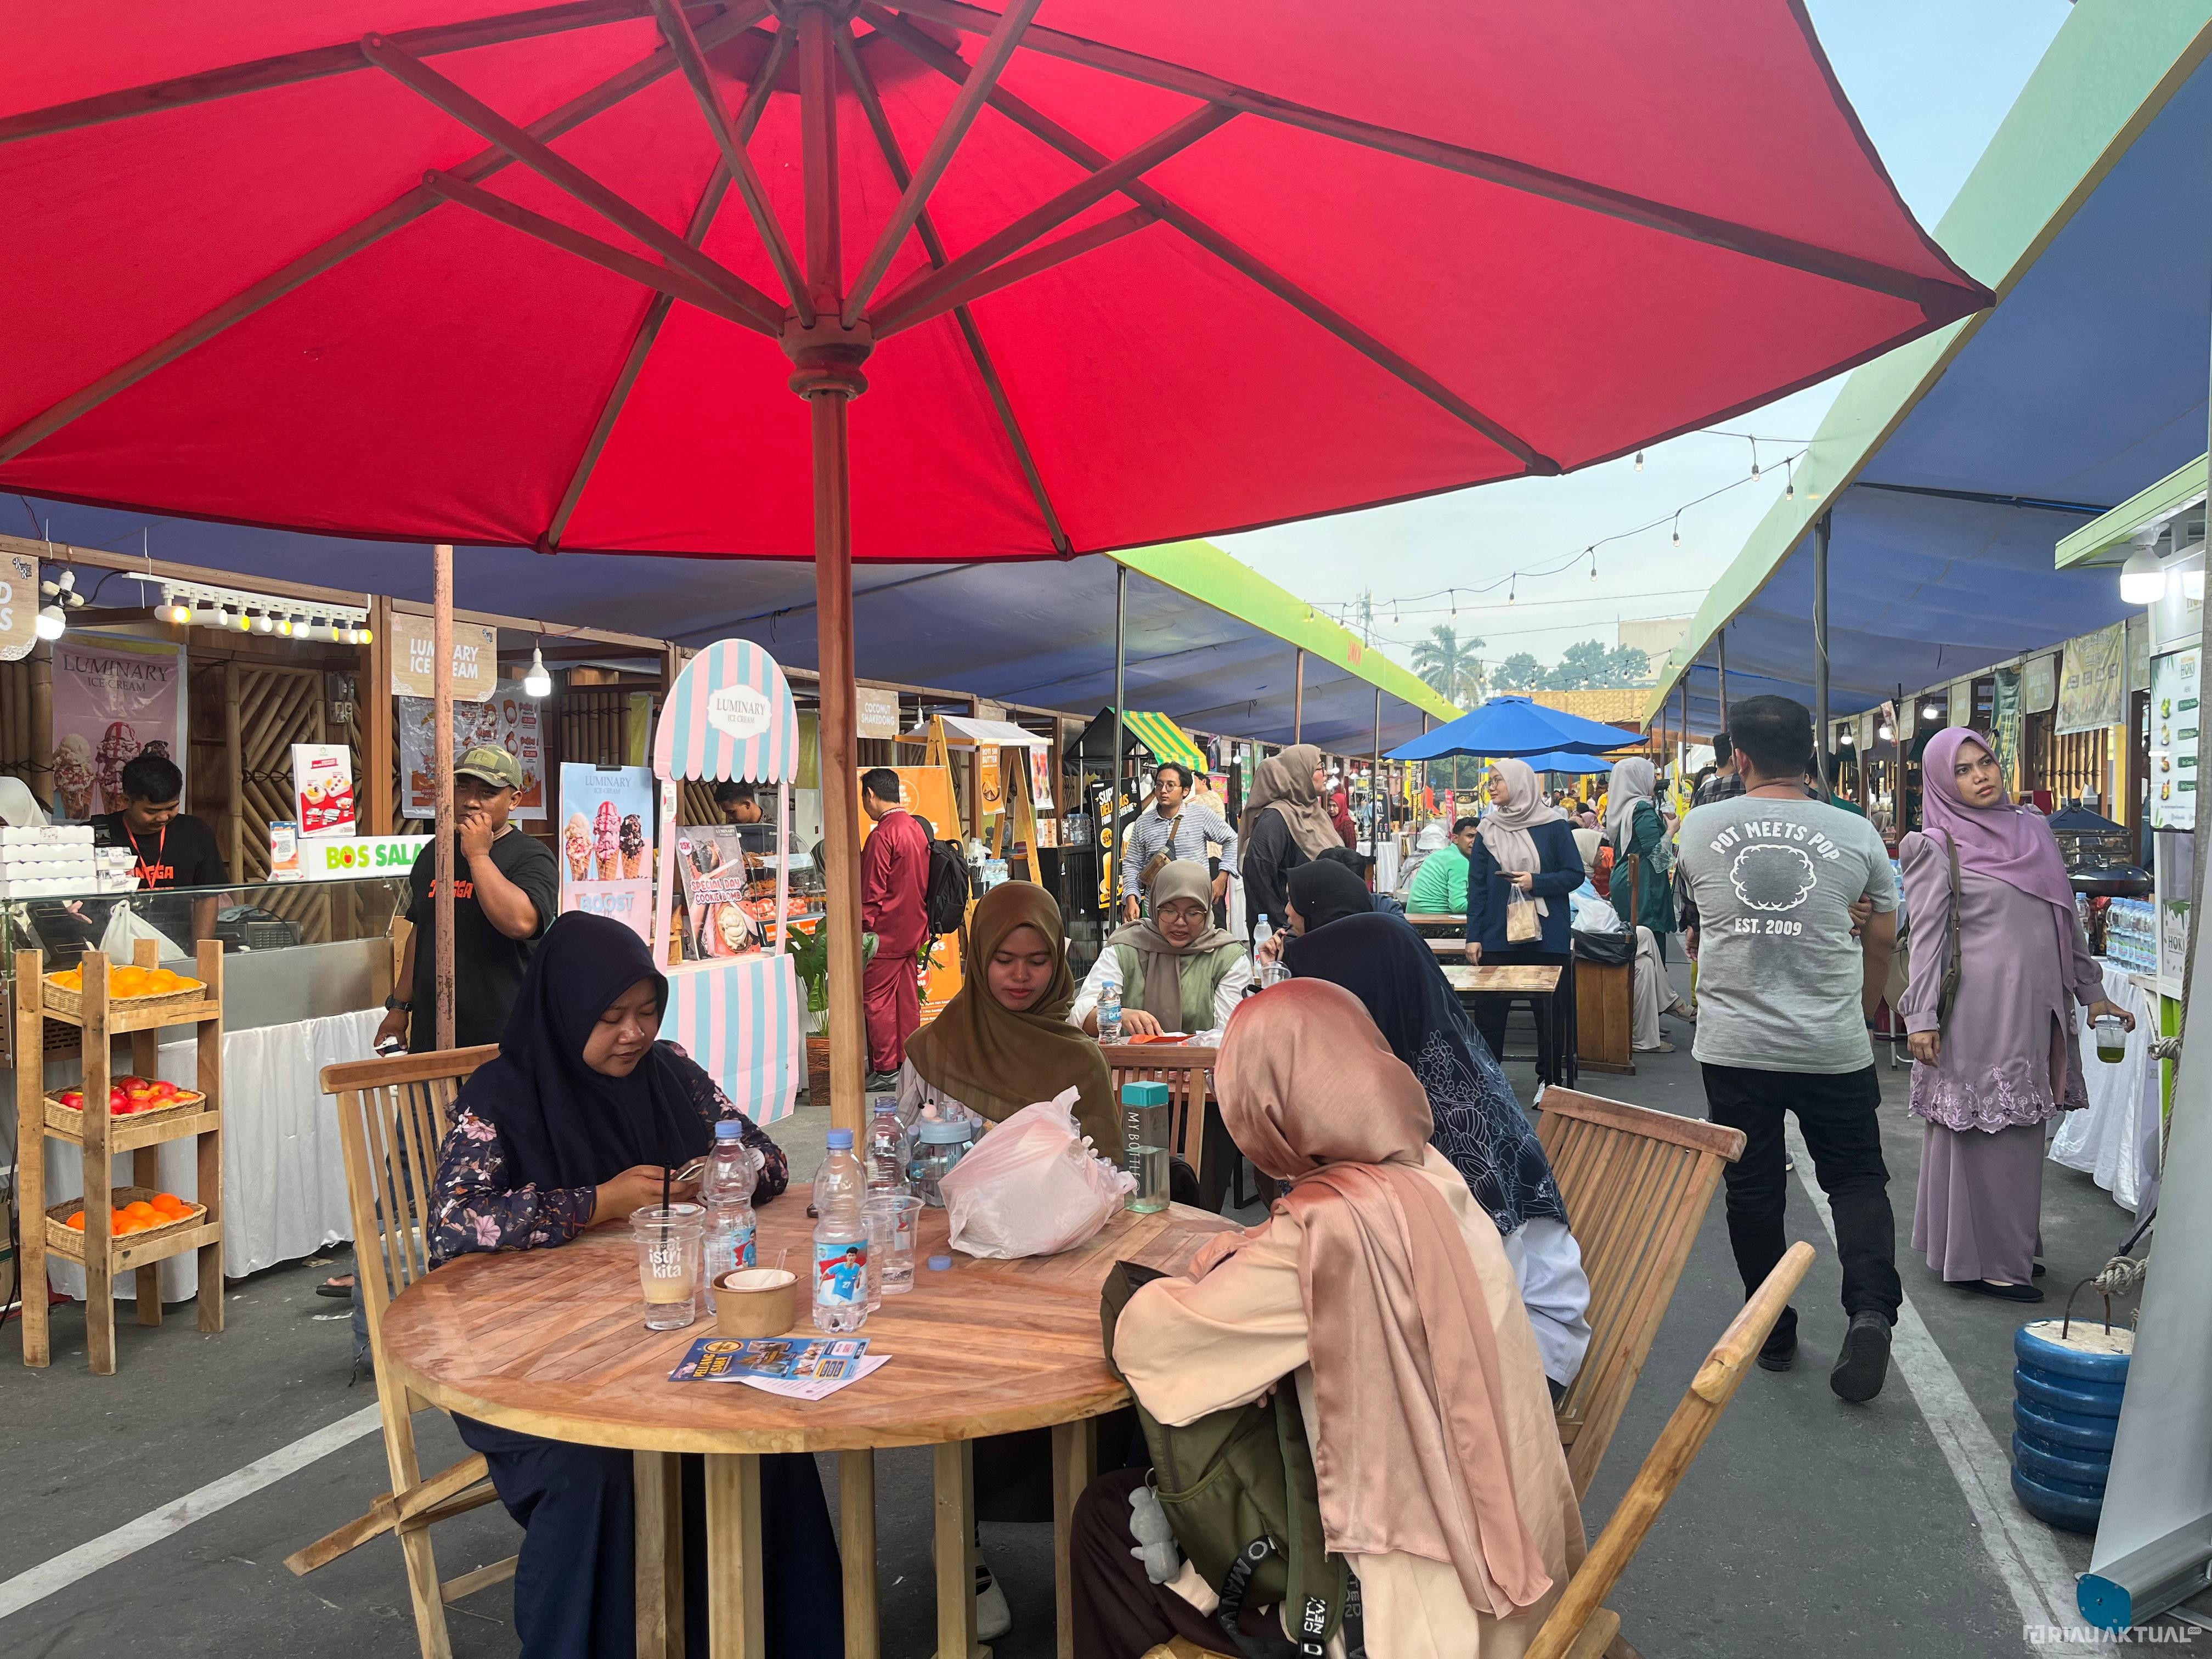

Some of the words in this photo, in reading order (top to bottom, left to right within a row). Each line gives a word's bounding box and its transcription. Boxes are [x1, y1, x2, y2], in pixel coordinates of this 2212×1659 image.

[410, 638, 479, 662] LUMARY
[64, 654, 169, 682] LUMINARY
[410, 656, 431, 674] ICE
[88, 677, 105, 688] ICE
[108, 679, 146, 692] CREAM
[716, 697, 766, 716] LUMINARY
[864, 702, 891, 715] COCONUT
[737, 715, 755, 724] CREAM
[860, 713, 895, 726] SHAKEDONG
[981, 755, 998, 764] BUTTER
[585, 775, 631, 787] LUMINARY
[1709, 826, 1741, 854] POT
[1744, 821, 1808, 841] MEETS
[1807, 832, 1840, 860] POP
[326, 845, 370, 870] BOS
[375, 843, 426, 867] SALA
[691, 880, 723, 891] SPECIAL
[724, 879, 741, 890] DAY
[580, 894, 635, 913] BOOST
[695, 893, 721, 904] COOKIE
[722, 890, 742, 902] BOMB
[1735, 918, 1761, 934] EST.
[1765, 919, 1802, 936] 2009
[2168, 935, 2185, 953] HOKI
[1127, 1111, 1140, 1130] MY
[648, 1249, 681, 1264] istri
[652, 1263, 682, 1278] kita
[842, 1281, 851, 1289] 27
